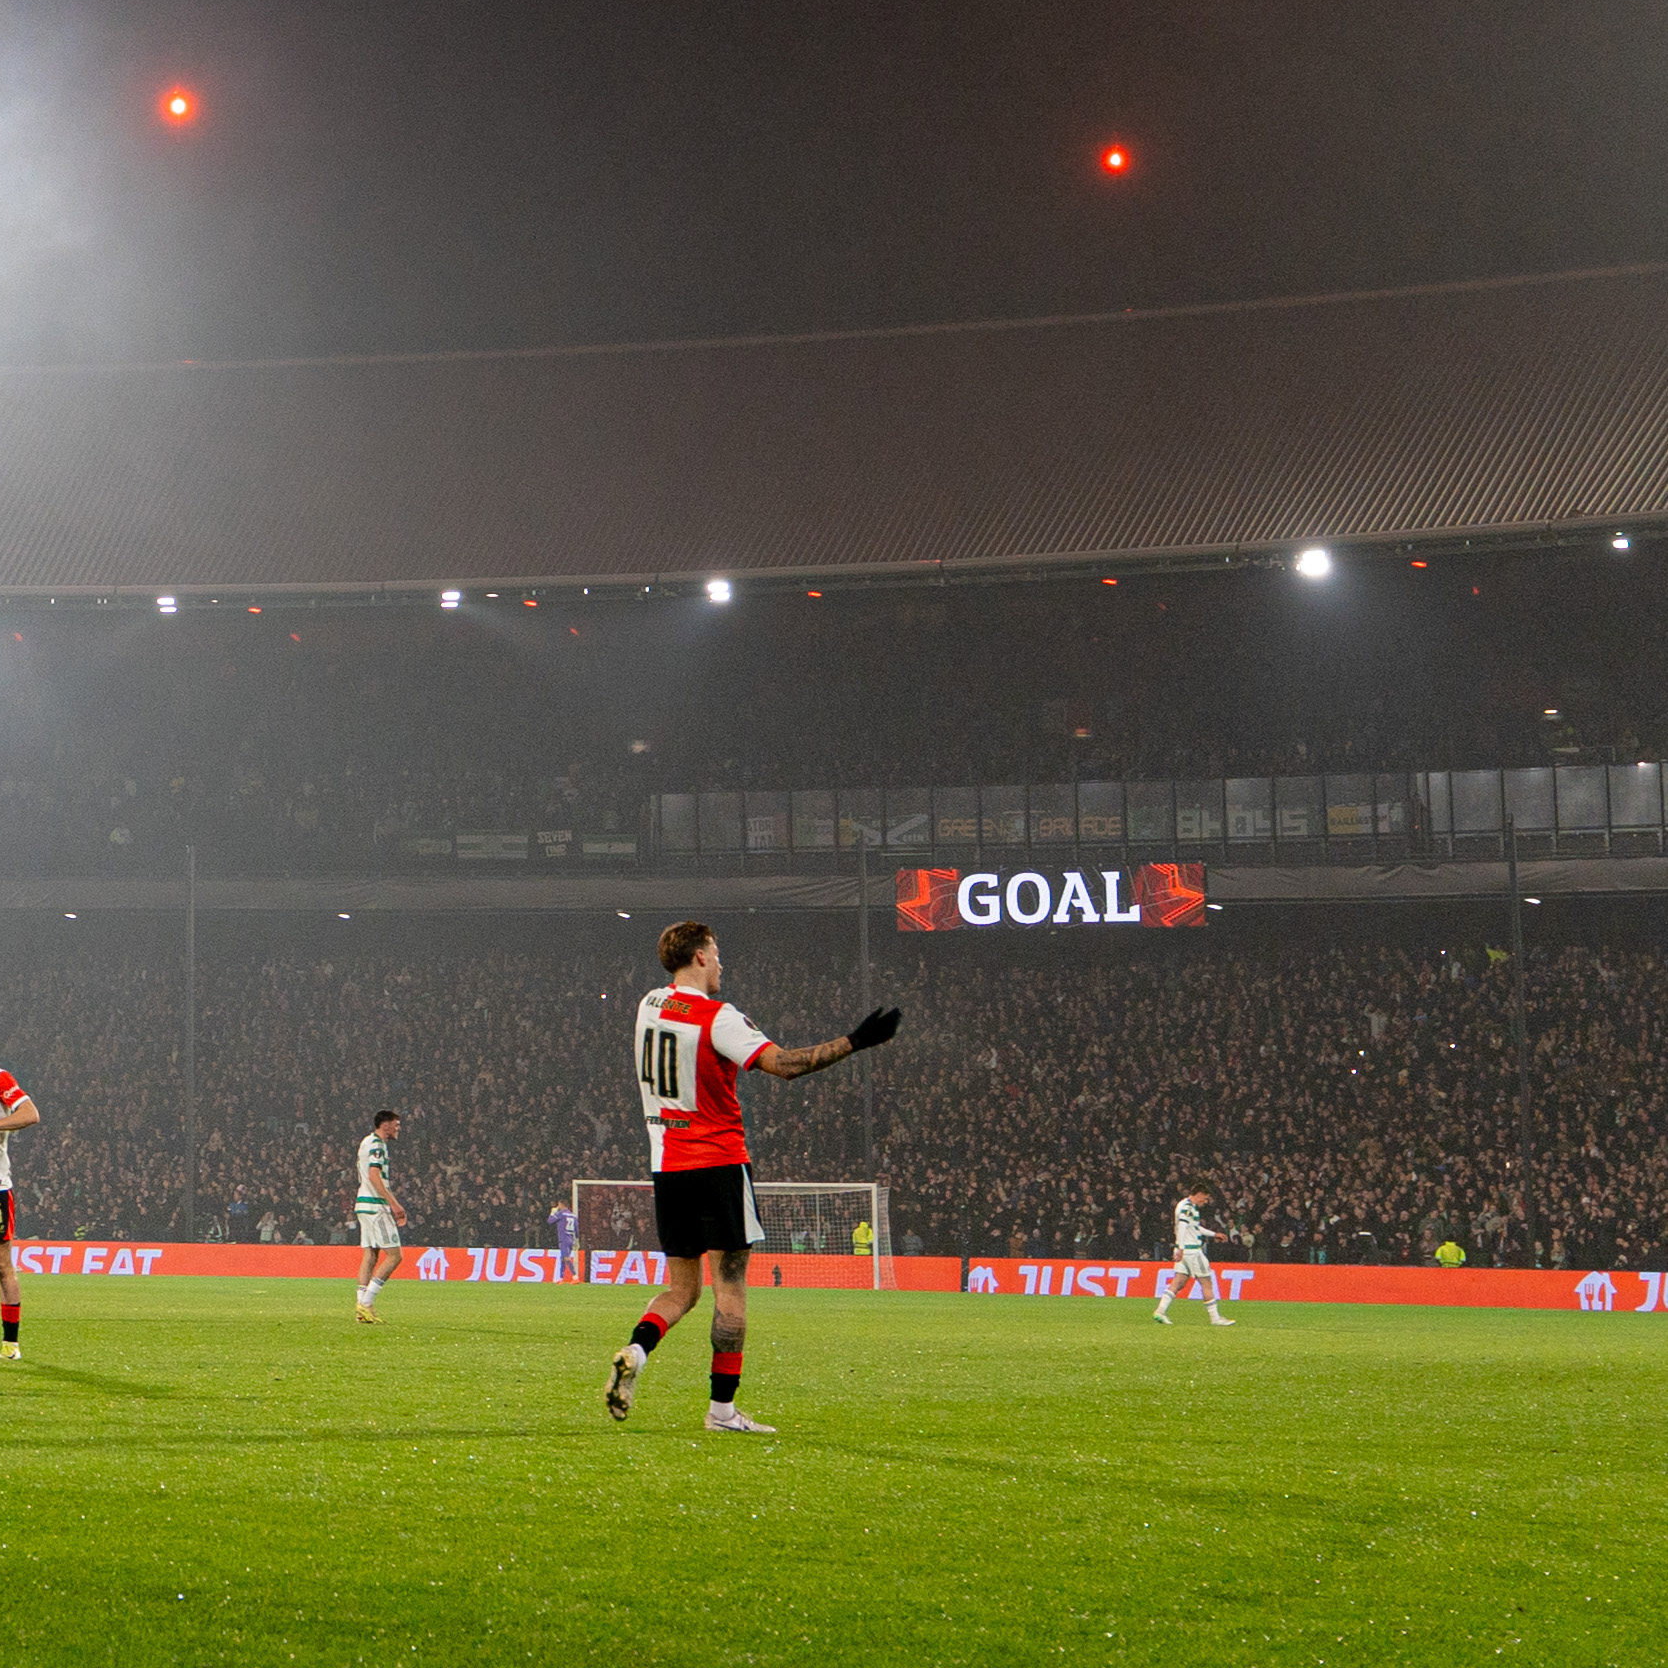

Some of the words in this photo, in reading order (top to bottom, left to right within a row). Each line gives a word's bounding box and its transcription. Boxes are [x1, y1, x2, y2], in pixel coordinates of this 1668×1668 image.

[957, 871, 1141, 926] GOAL
[642, 1028, 679, 1099] 40
[82, 1247, 163, 1275] EAT
[465, 1248, 574, 1283] JUST
[590, 1250, 667, 1285] EAT
[1018, 1265, 1140, 1297] JUST
